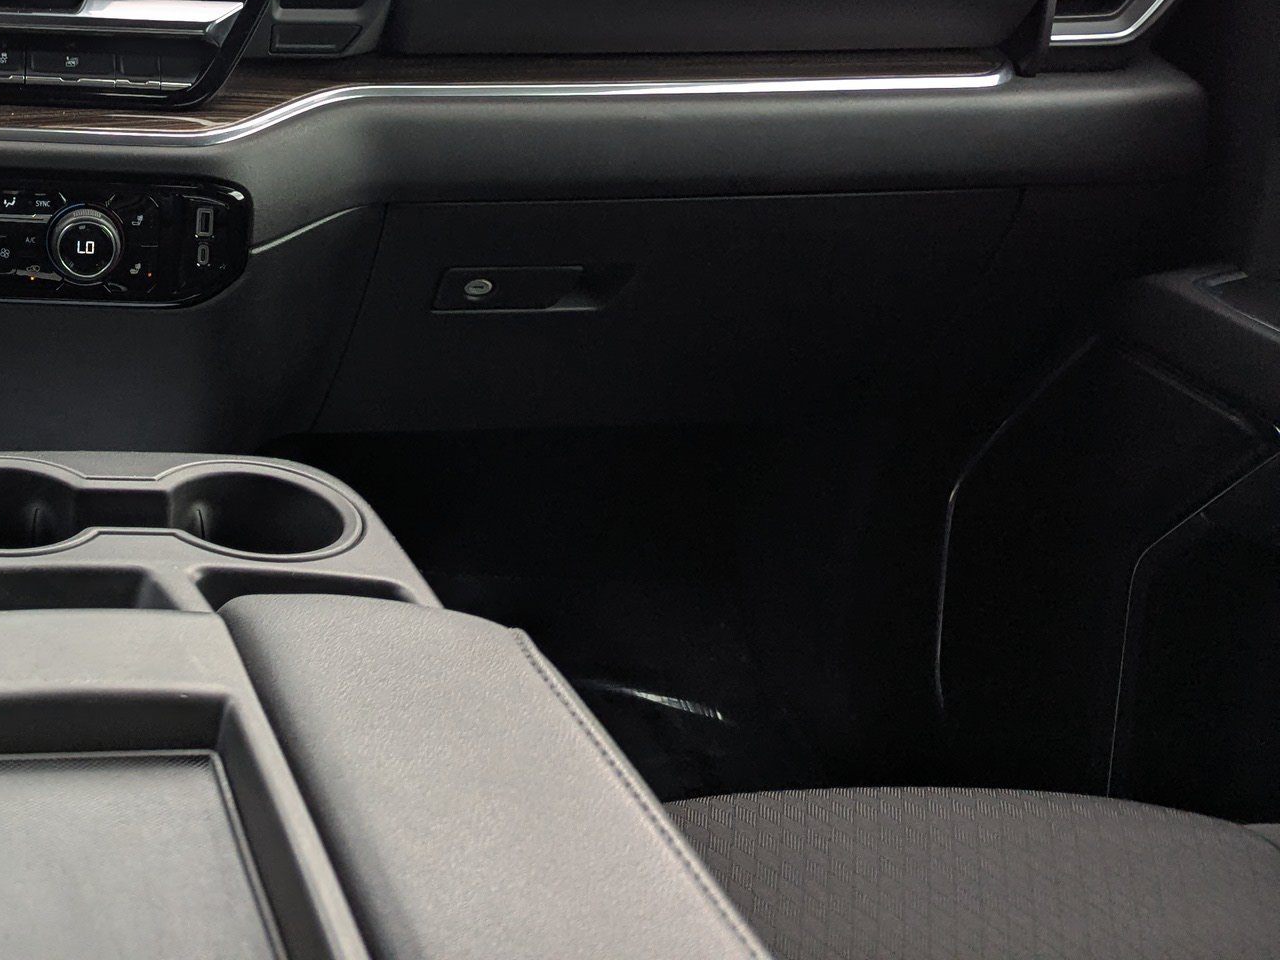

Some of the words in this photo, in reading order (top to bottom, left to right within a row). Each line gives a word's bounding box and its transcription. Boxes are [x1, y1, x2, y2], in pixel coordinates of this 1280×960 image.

[35, 200, 50, 208] SYNC
[25, 236, 36, 244] A/C
[77, 240, 95, 254] LO
